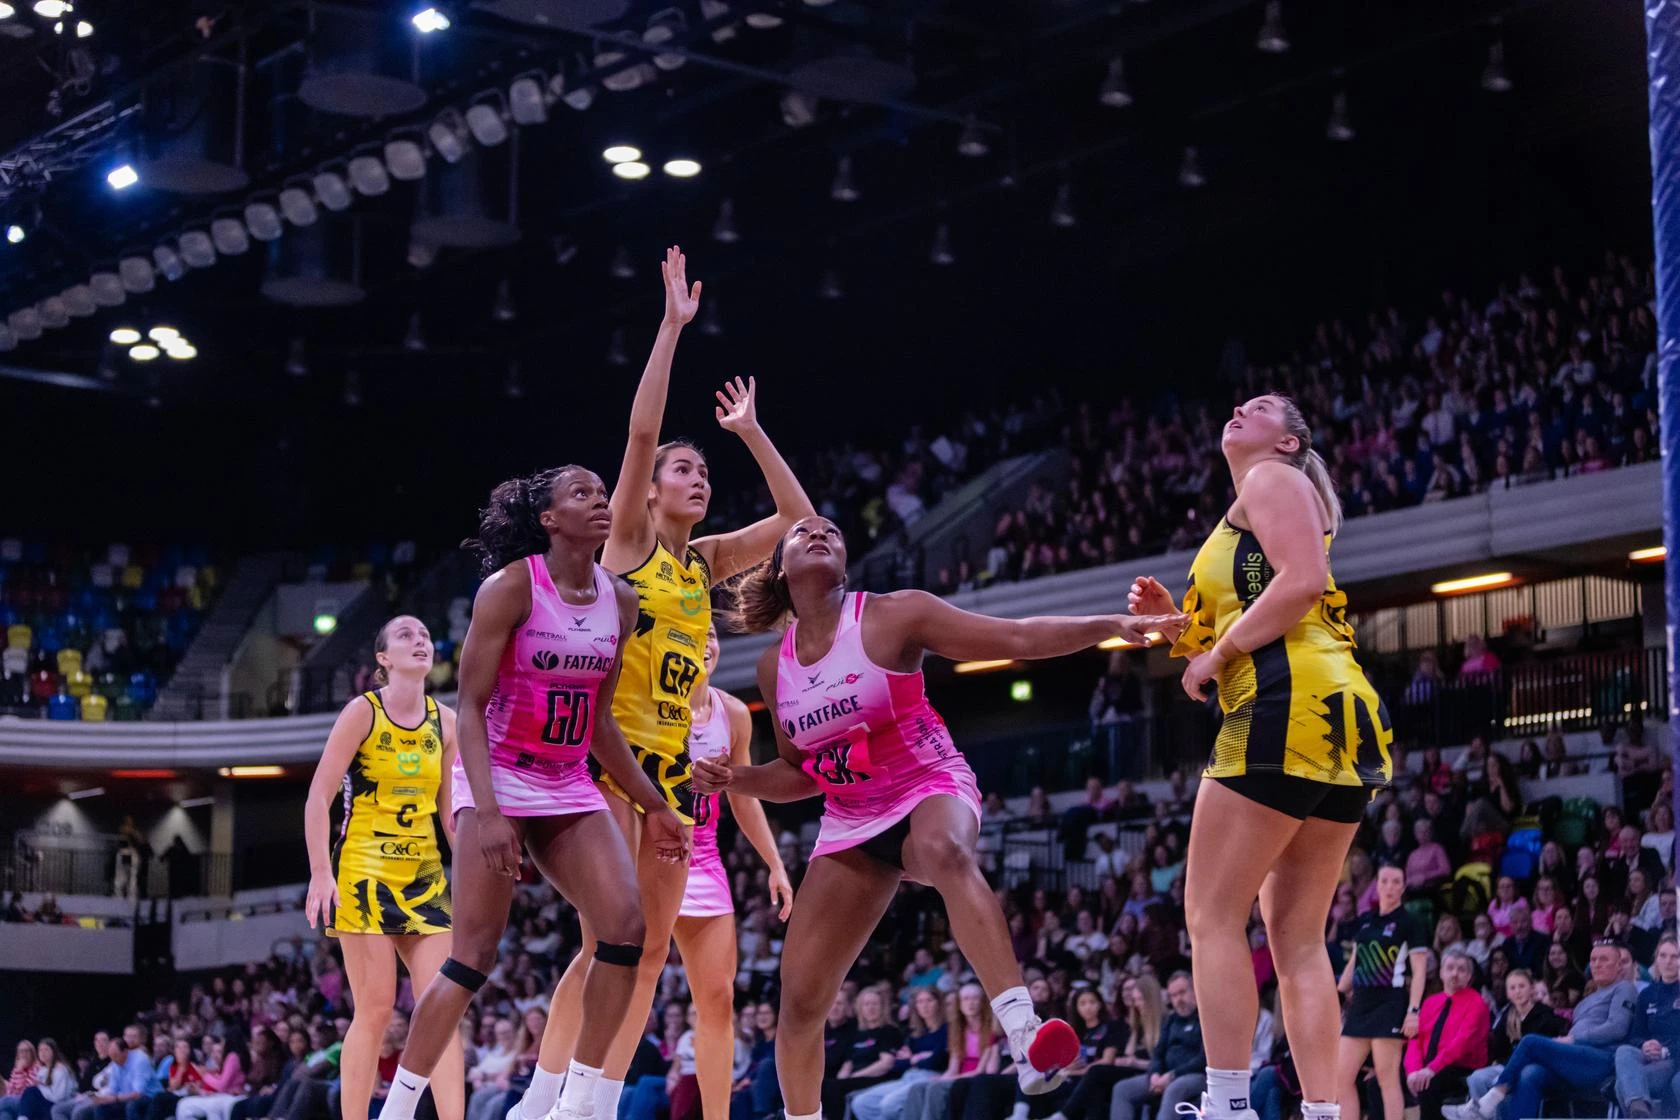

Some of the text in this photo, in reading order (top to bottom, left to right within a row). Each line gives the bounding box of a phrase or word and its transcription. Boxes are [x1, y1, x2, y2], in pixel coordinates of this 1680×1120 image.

[660, 651, 700, 699] GA
[541, 690, 589, 747] GD
[798, 695, 863, 732] FATFACE
[396, 804, 417, 828] C
